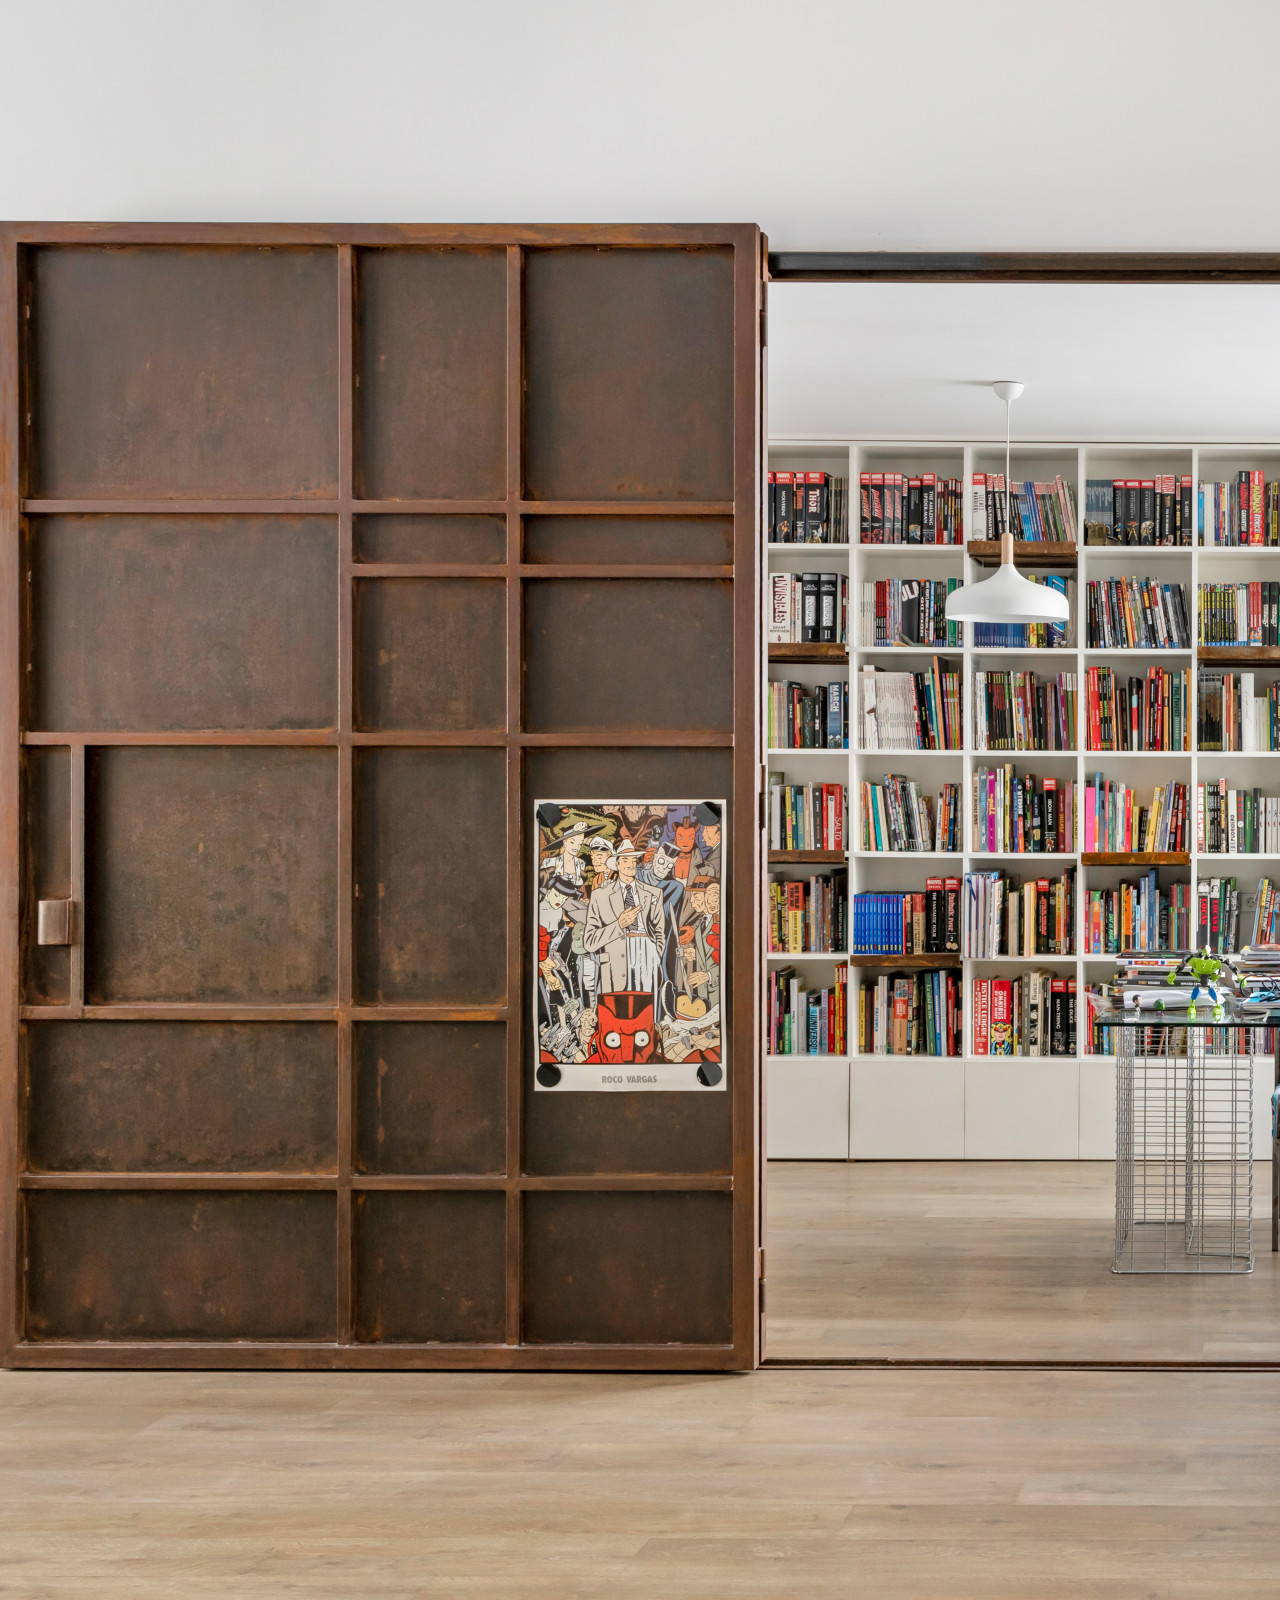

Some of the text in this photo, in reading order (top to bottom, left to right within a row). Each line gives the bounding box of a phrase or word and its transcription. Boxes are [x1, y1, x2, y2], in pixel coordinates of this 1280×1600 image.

[808, 489, 820, 514] THOR
[1240, 483, 1249, 510] MADMAN
[1253, 485, 1263, 514] MADMAN
[773, 576, 788, 624] INVISIBLES
[901, 581, 920, 602] JLA
[834, 816, 842, 841] SALTO
[980, 981, 988, 1037] JUSTICE LEAGUE
[602, 1075, 657, 1083] ROCO VARGAS
